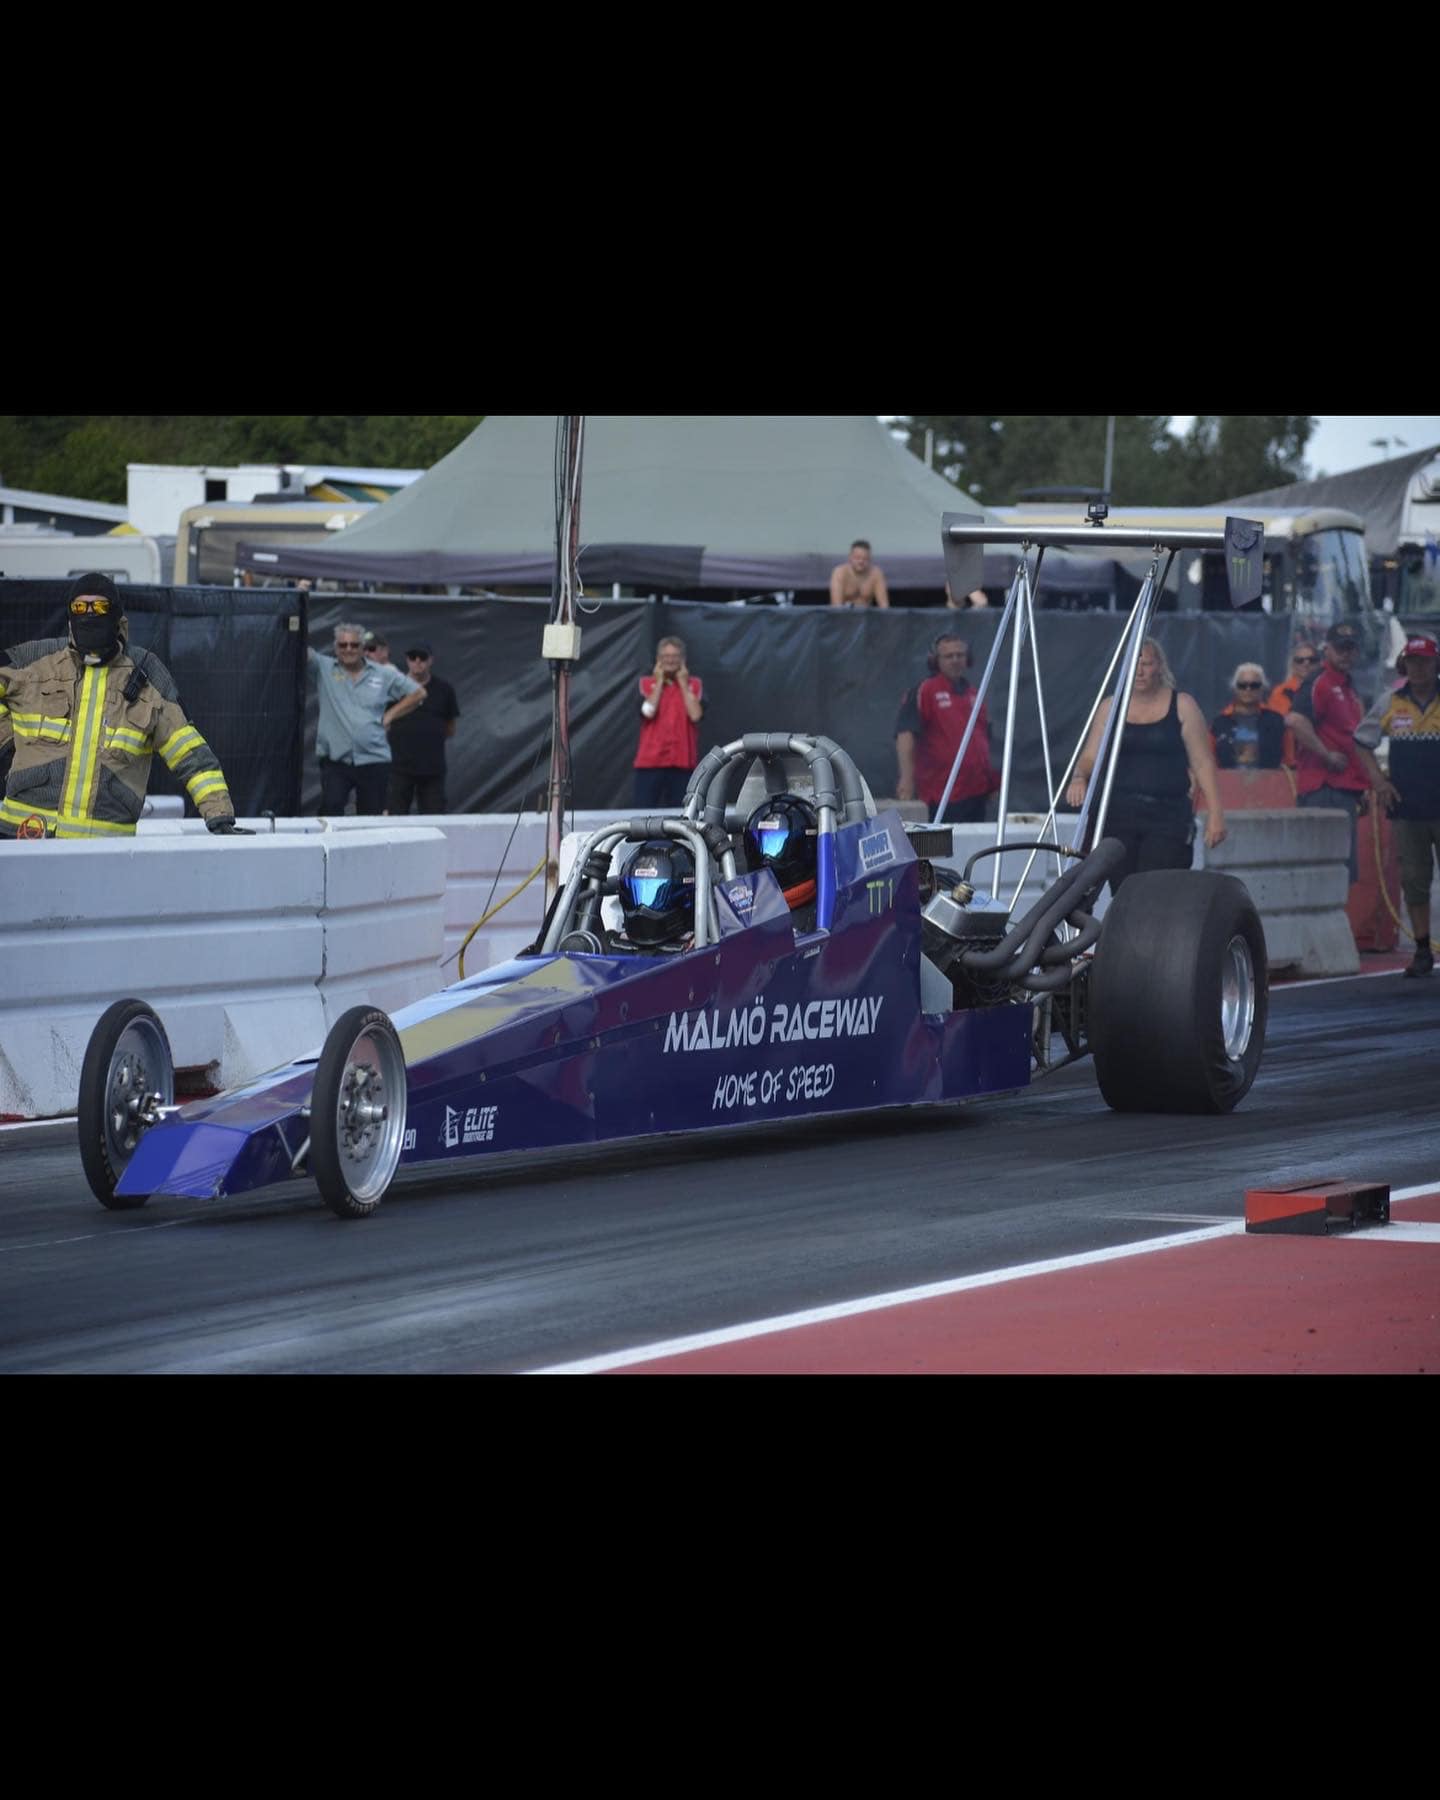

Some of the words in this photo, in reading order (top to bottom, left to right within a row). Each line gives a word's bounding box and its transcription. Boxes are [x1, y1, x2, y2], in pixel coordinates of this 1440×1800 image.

[663, 996, 766, 1053] MALMÖ
[770, 996, 884, 1043] RACEWAY
[712, 1071, 757, 1110] HOME
[760, 1069, 784, 1104] OF
[786, 1064, 835, 1101] SPEED
[464, 1105, 498, 1131] ELITE
